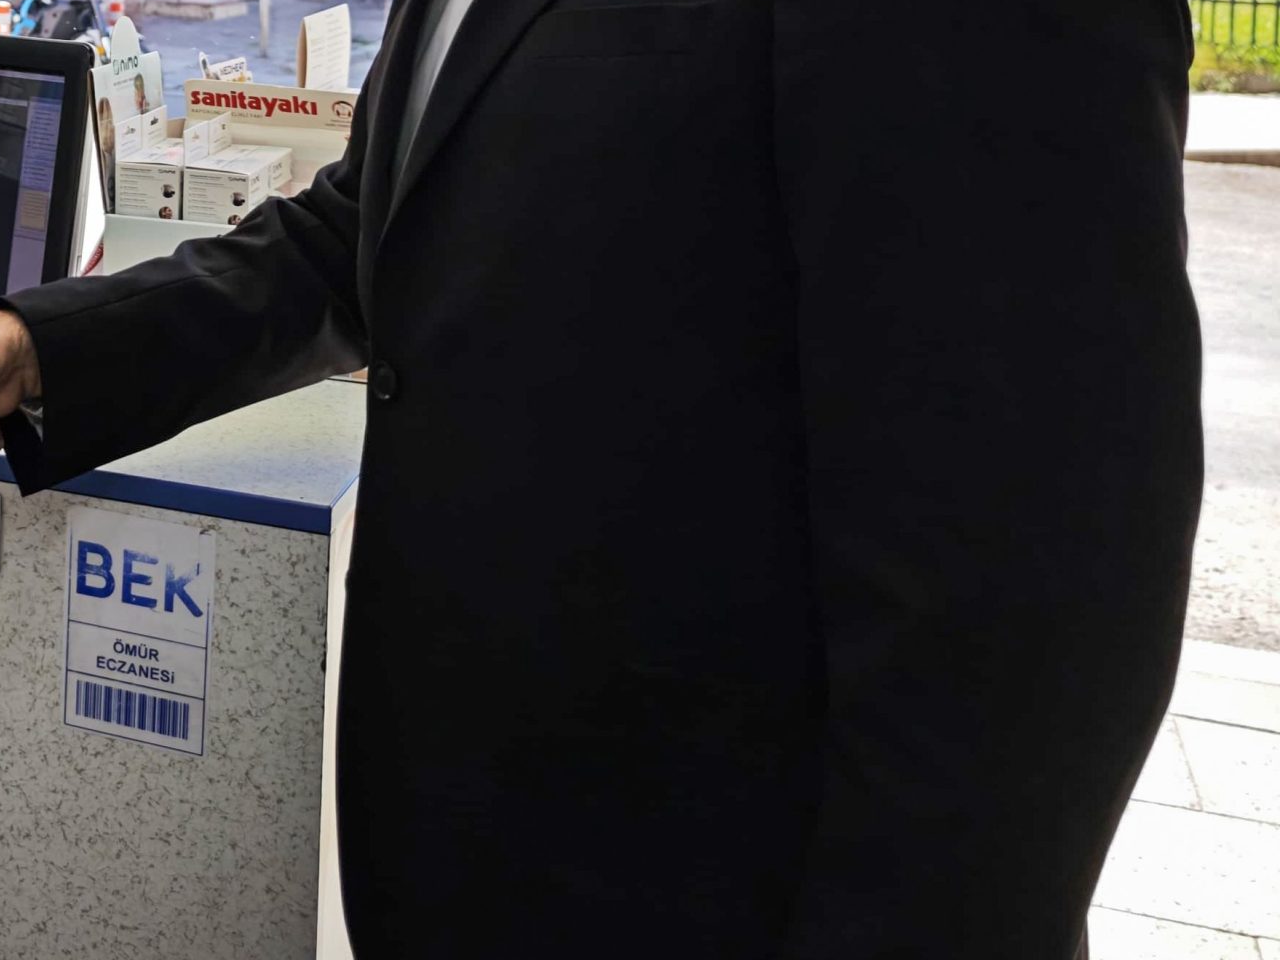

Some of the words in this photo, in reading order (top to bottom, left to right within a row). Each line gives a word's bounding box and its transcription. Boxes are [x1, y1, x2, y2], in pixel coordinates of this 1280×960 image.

[190, 90, 318, 117] sanitayakı
[75, 540, 204, 619] BEK
[113, 639, 160, 663] ÖMÜR
